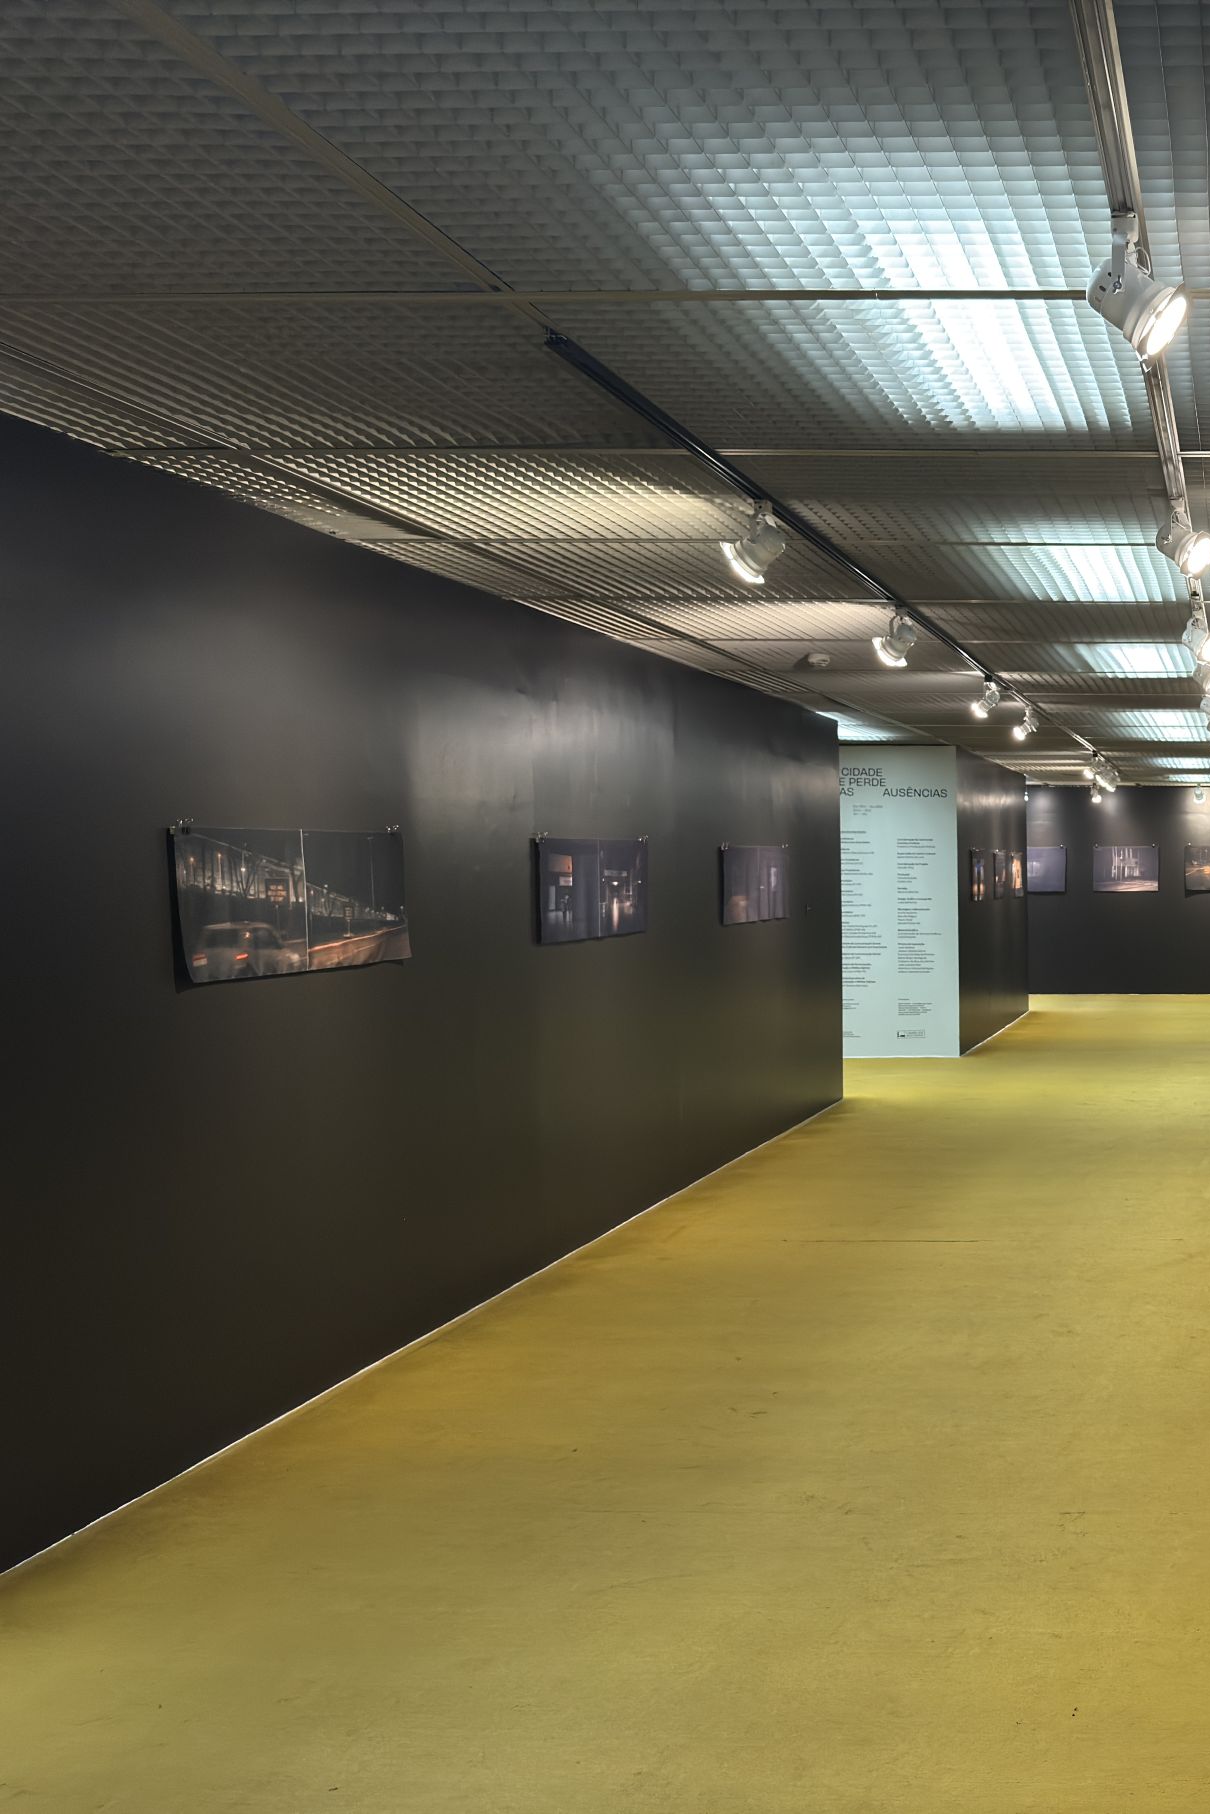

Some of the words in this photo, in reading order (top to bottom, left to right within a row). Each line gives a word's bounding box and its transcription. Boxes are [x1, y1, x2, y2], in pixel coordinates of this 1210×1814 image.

[841, 767, 883, 777] CIDADE
[849, 777, 886, 787] PERDE
[883, 787, 948, 798] AUSÊNCIAS
